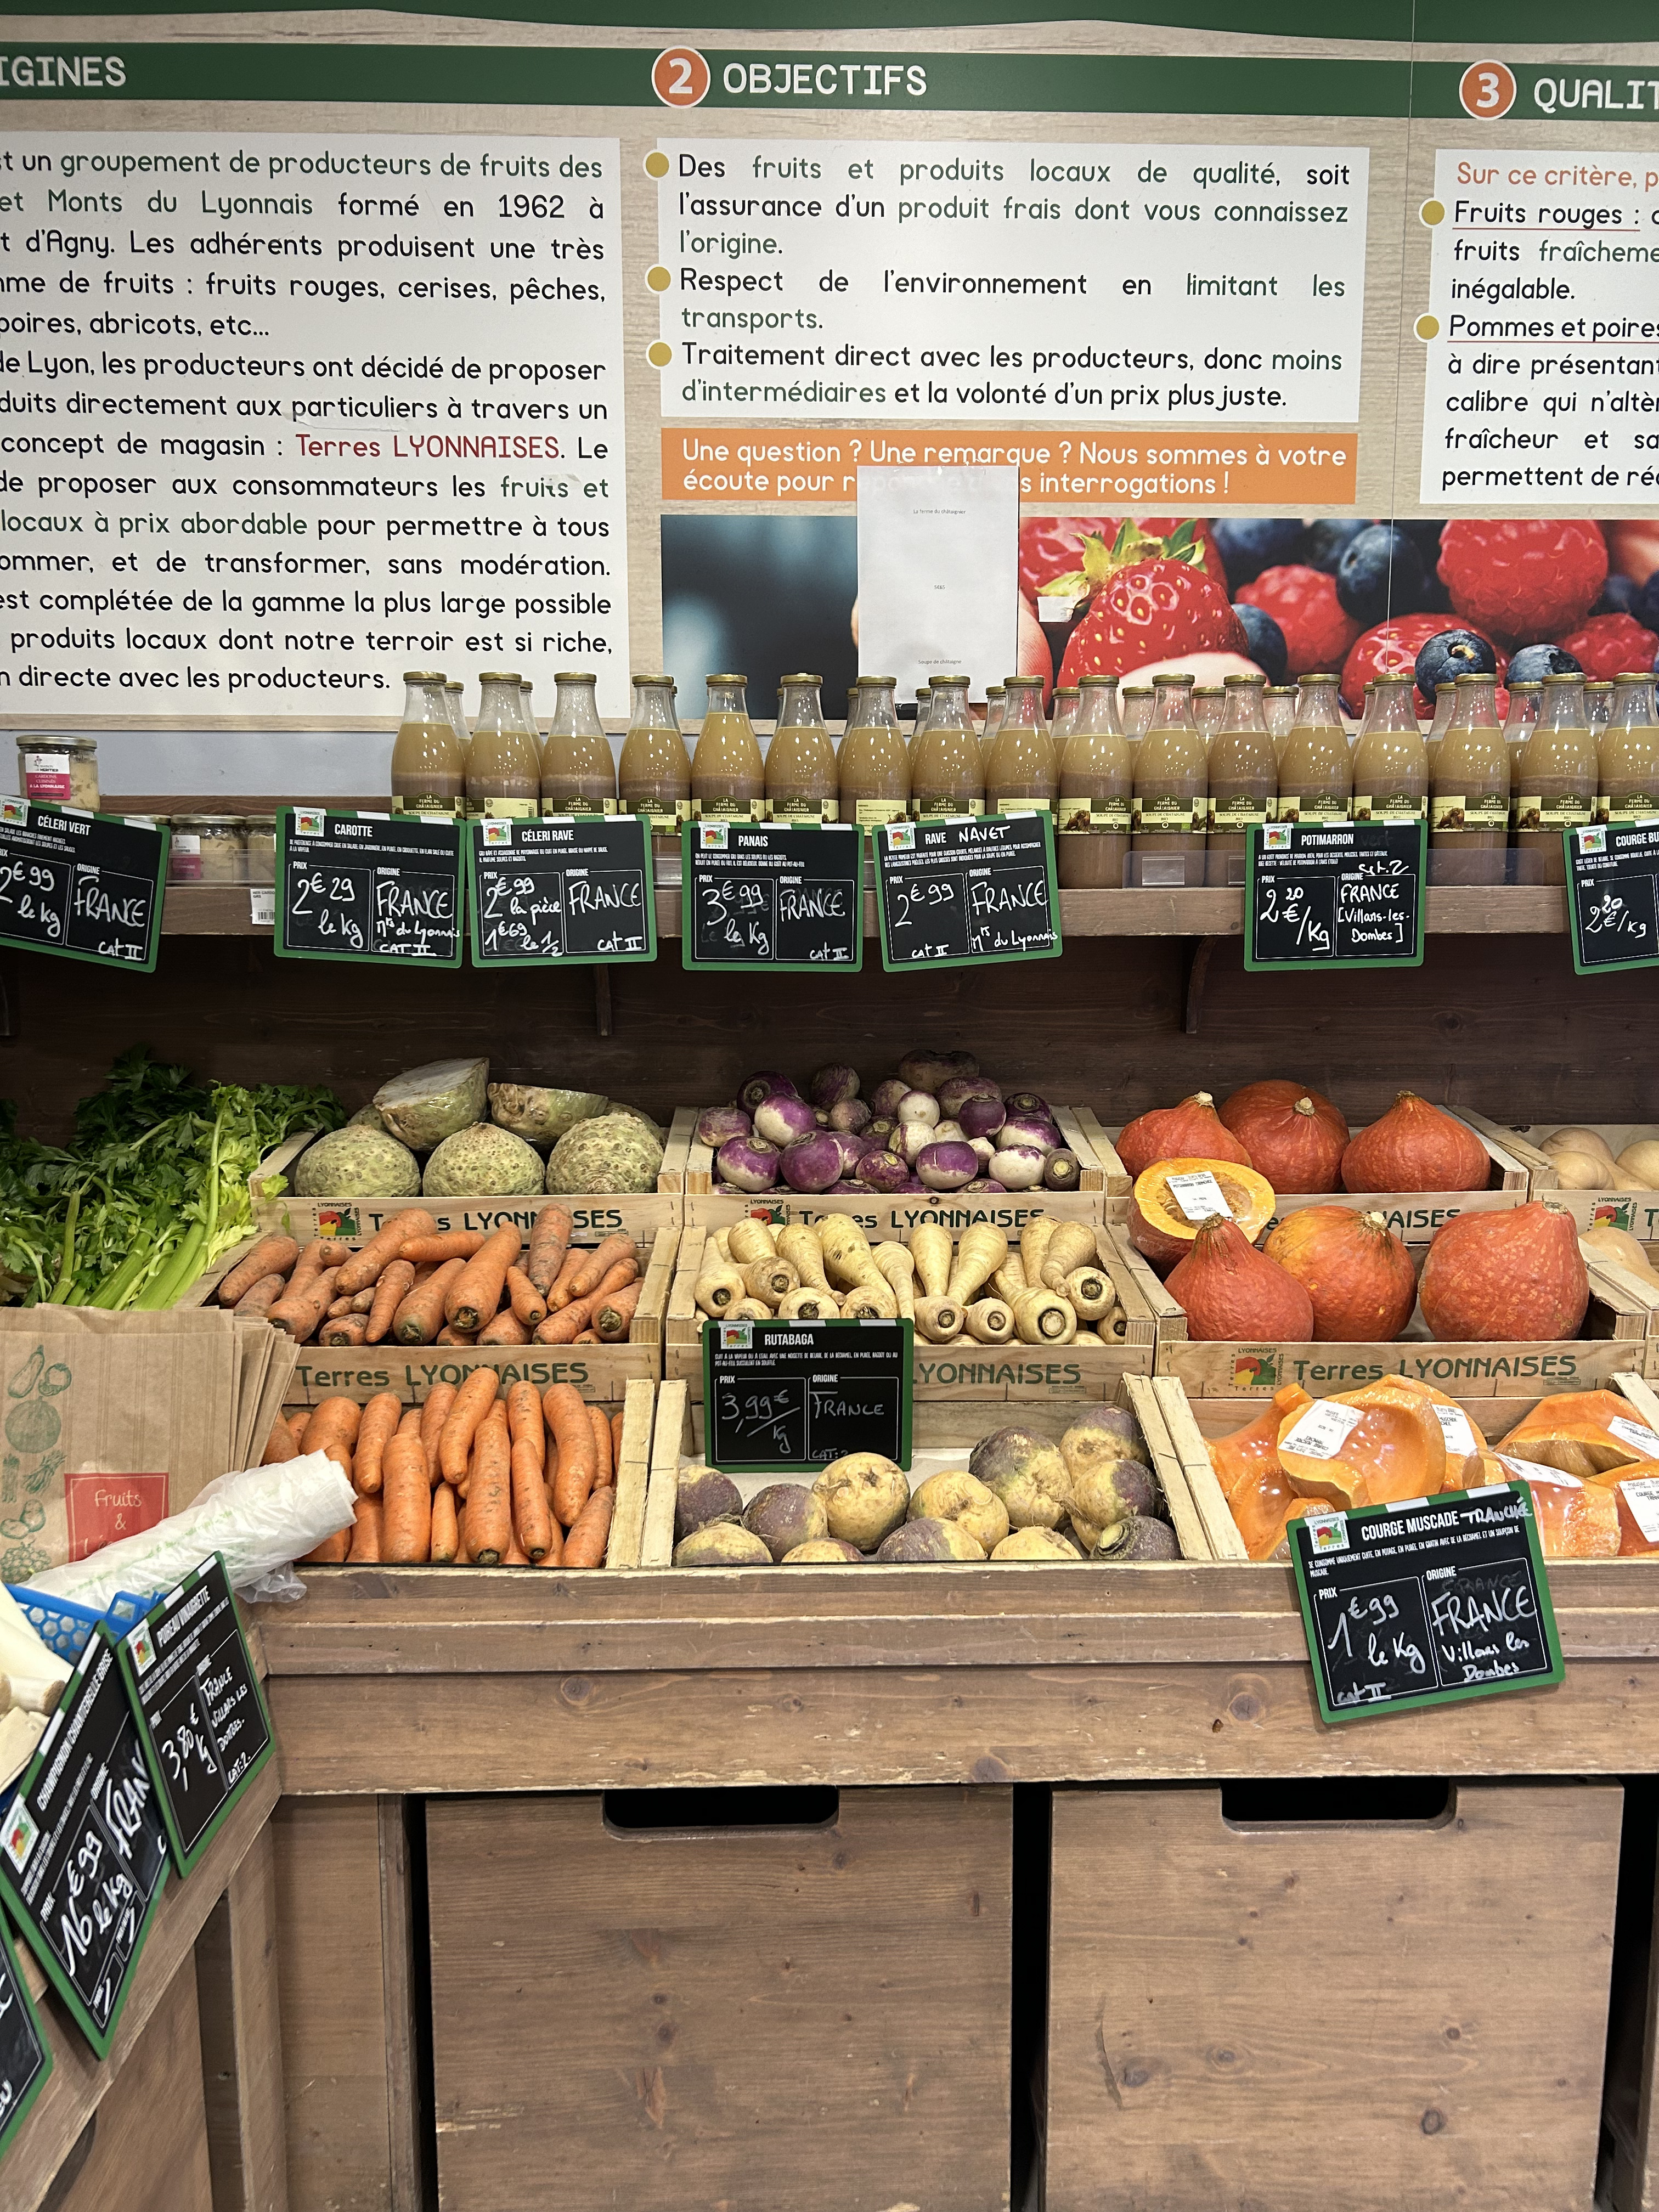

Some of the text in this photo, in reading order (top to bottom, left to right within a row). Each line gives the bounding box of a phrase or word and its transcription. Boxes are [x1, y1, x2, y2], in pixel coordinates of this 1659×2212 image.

[668, 59, 927, 95] 2 OBJECTIFS
[1476, 72, 1659, 113] 3 QUALIT
[680, 154, 1349, 189] Des fruits et produits locaux de qualité, soit
[1458, 162, 1637, 188] Sur ce critère,
[680, 192, 1347, 223] l'assurance d'un produit frais dont vous connaissez
[681, 230, 782, 259] l'origine.
[1452, 277, 1575, 304] inégalable.
[1, 432, 608, 460] concept de magasin Terres LYONNAISES. Le
[684, 439, 1347, 472] Une question ? Une remarque ? Nous sommes à votre
[38, 815, 91, 836] CÉLERI VERT
[335, 823, 373, 837] CAROTTE
[522, 829, 574, 842] CÉLERI RAVE
[925, 825, 1011, 845] RAVE NAVET
[738, 836, 769, 847] PANAIS
[1301, 833, 1354, 846] POTIMARRON
[1616, 833, 1647, 847] COURGE
[77, 863, 100, 875] ORIGINE
[293, 861, 400, 876] PRIX ORIGINE
[566, 868, 589, 877] ORIGINE
[780, 876, 802, 884] ORIGINE
[969, 868, 992, 877] ORIGINE
[74, 876, 146, 928] FRANCE
[376, 881, 453, 919] FRANCE
[568, 880, 642, 916] FRANCE
[780, 888, 846, 922] FRANCE
[970, 879, 1049, 916] FRANCE
[1340, 883, 1400, 904] FRANCE
[764, 1333, 814, 1346] RUTABAGA
[296, 1365, 390, 1387] Terres
[720, 1374, 838, 1384] PRIX ORIGINE
[913, 1362, 1081, 1384] YONNAISES
[1294, 1355, 1577, 1381] Terres LYONNAISES
[809, 1391, 884, 1419] FRANCE
[94, 1489, 142, 1508] Fruits
[115, 1514, 126, 1531] &
[1361, 1520, 1405, 1541] COURGE
[1407, 1511, 1460, 1534] MUSCADE
[1318, 1566, 1457, 1599] PRIX ORIGINE
[1431, 1585, 1537, 1636] FRANCE
